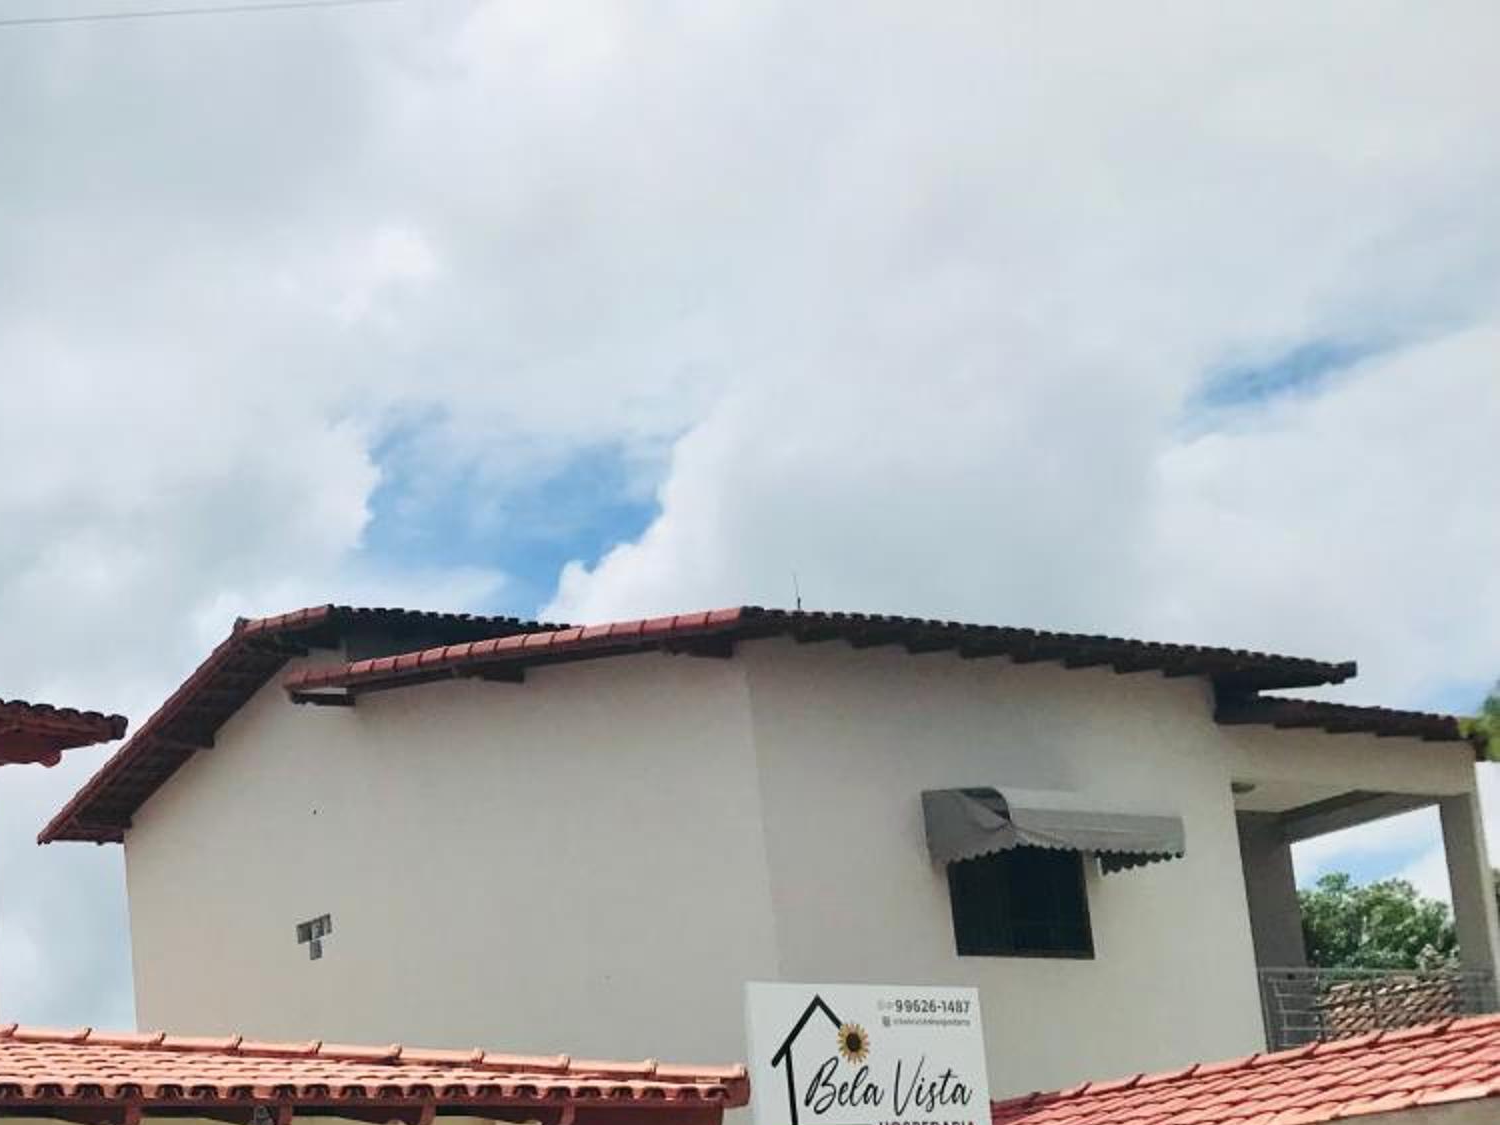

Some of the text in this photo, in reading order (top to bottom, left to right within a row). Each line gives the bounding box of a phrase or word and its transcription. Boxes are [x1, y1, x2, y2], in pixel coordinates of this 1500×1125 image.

[895, 999, 970, 1013] 99626-1487
[804, 1056, 973, 1116] Bela Vista
